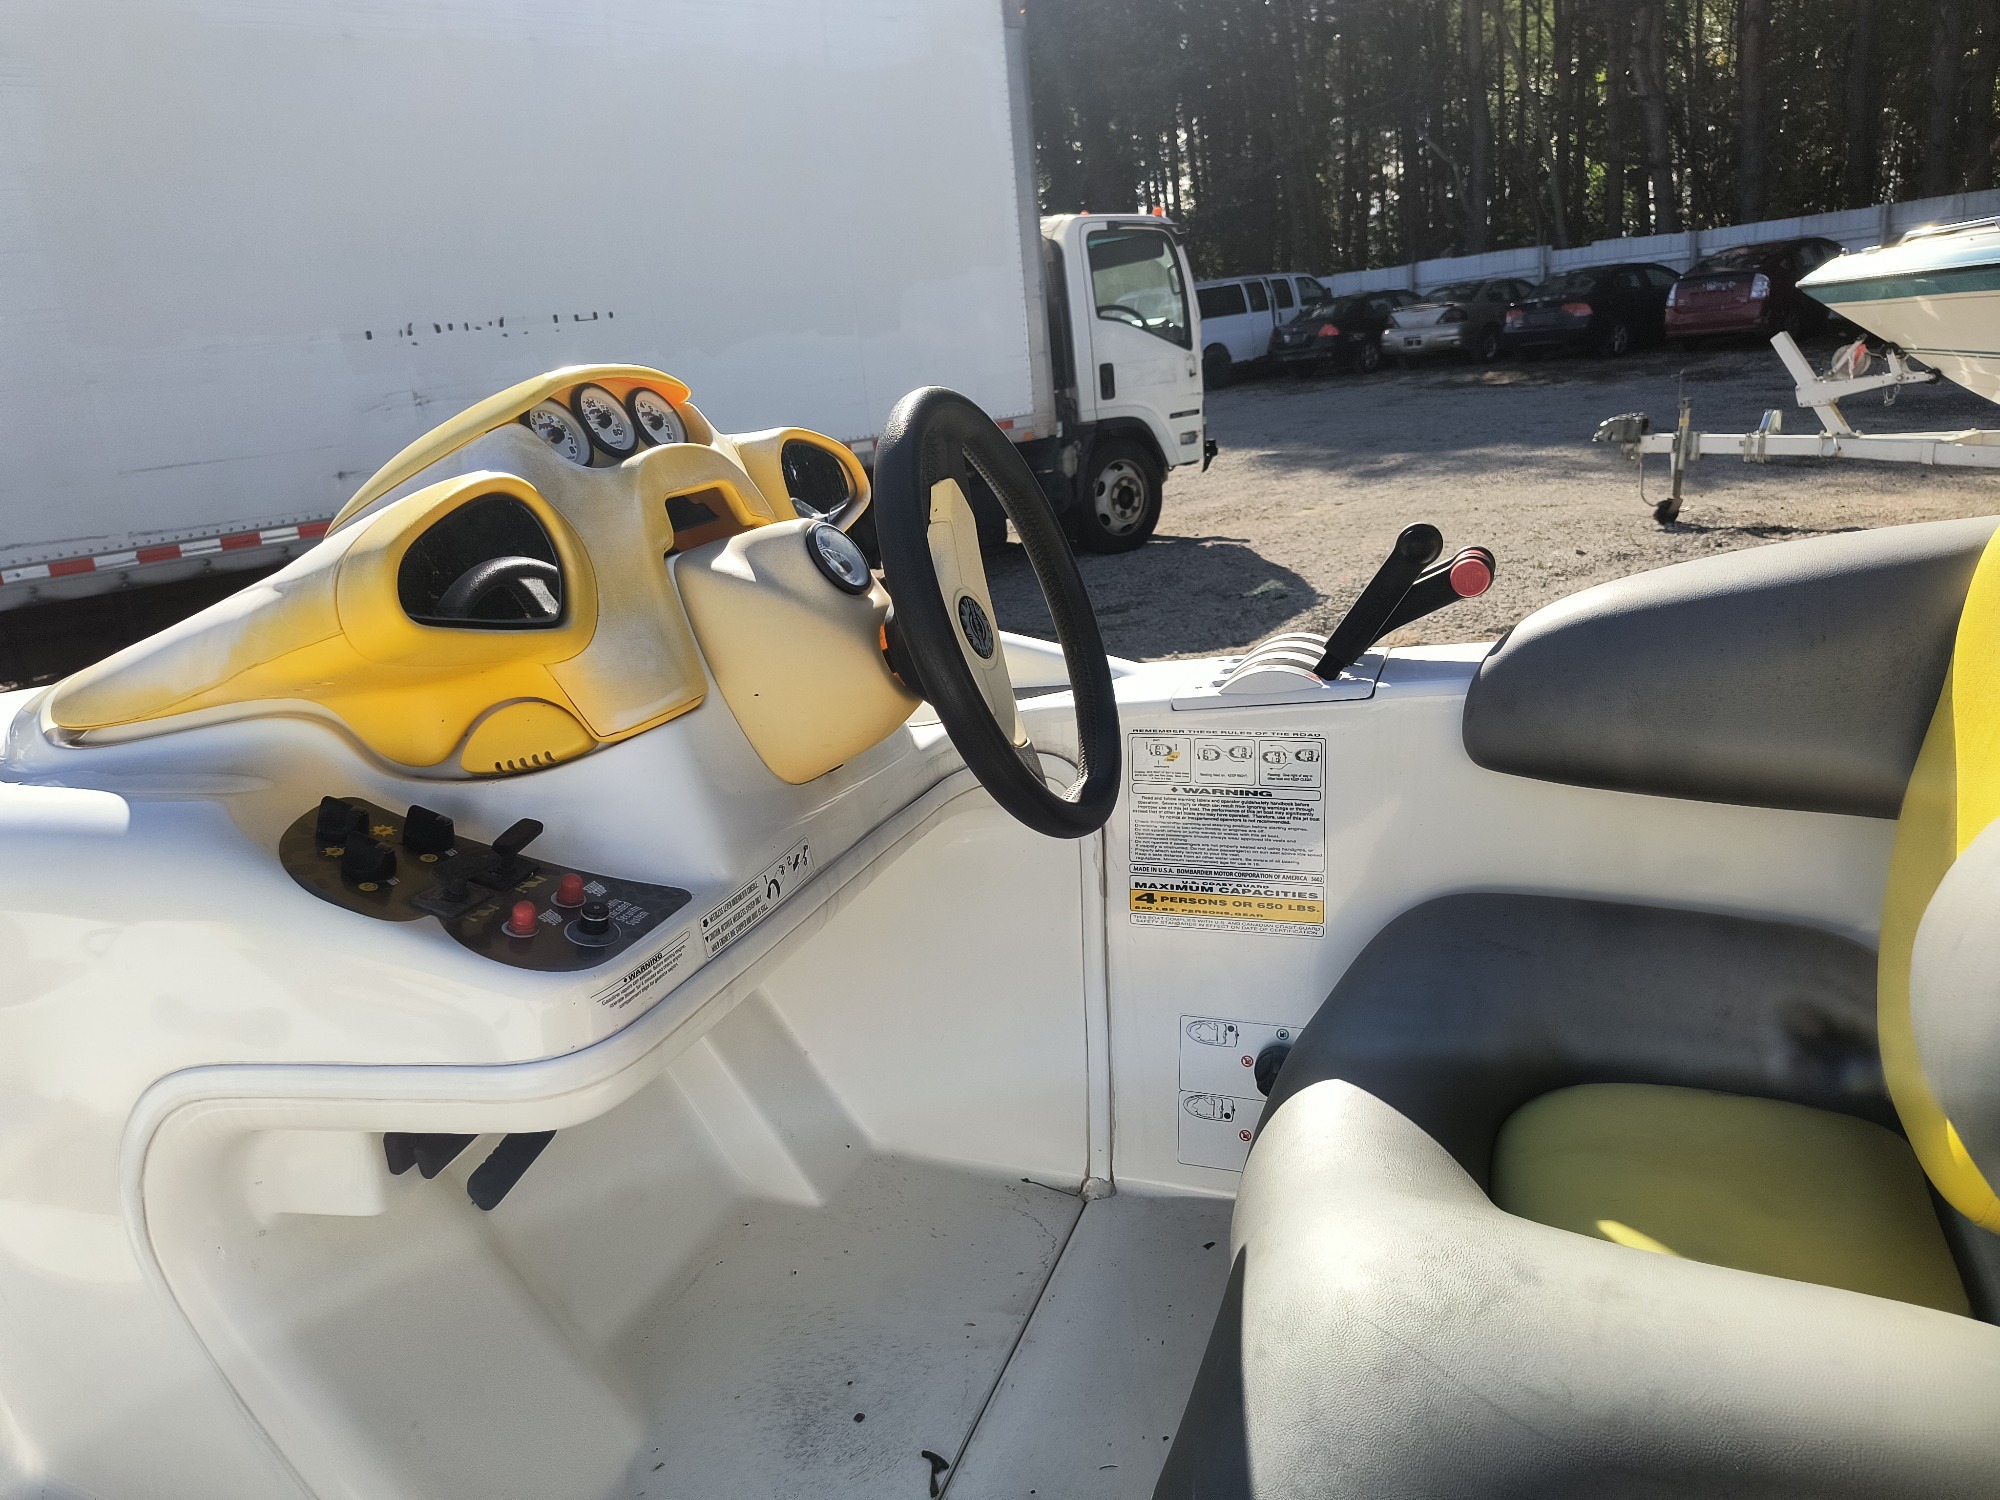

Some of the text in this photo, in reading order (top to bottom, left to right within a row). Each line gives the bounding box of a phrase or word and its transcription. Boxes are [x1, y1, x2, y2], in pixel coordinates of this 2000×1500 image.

[1182, 788, 1273, 797] WARNING
[1176, 868, 1212, 876] BOMBARDIER
[1135, 882, 1318, 899] MAXIMUM CAPACITIES
[1135, 893, 1320, 912] 4 PERSONS OR 650 LBS.
[628, 953, 663, 981] WARNING
